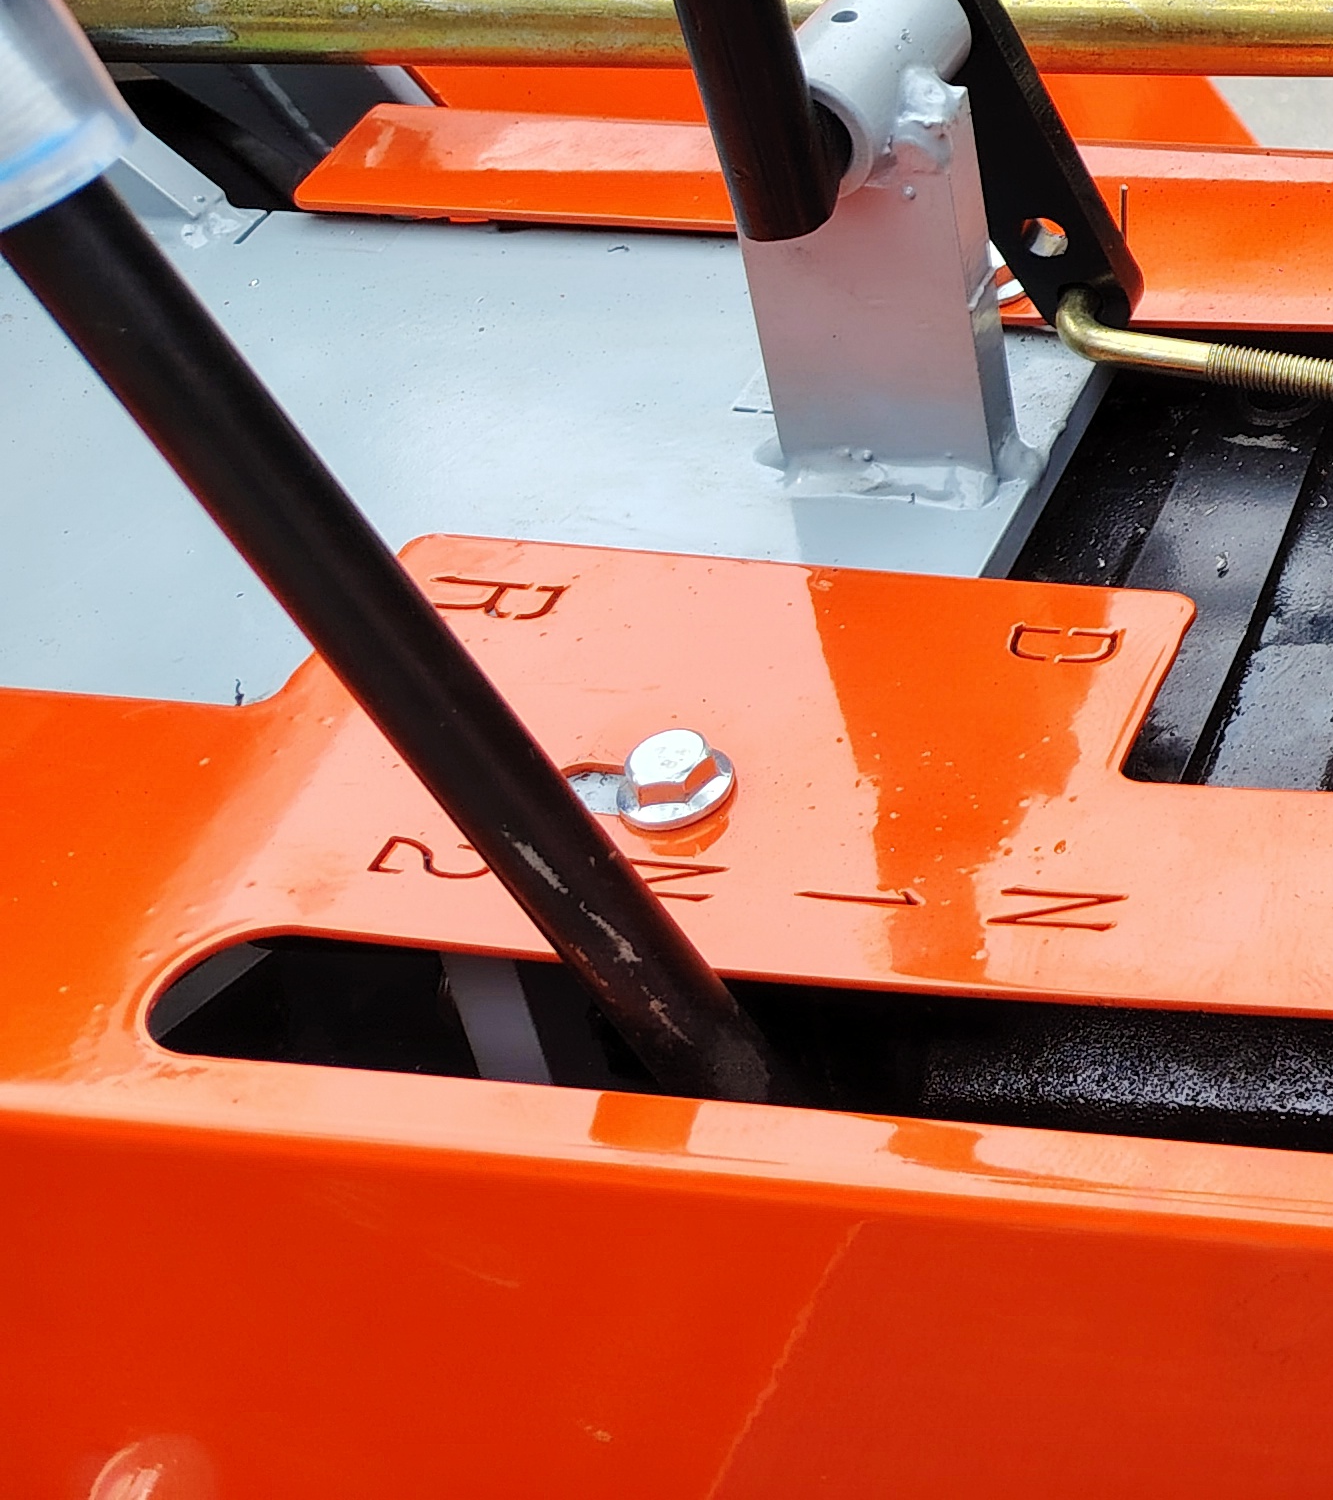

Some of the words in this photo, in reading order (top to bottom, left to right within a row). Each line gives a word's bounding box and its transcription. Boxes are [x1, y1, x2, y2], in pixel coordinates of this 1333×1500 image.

[430, 575, 570, 620] R
[1008, 622, 1124, 664] D
[986, 886, 1130, 932] N
